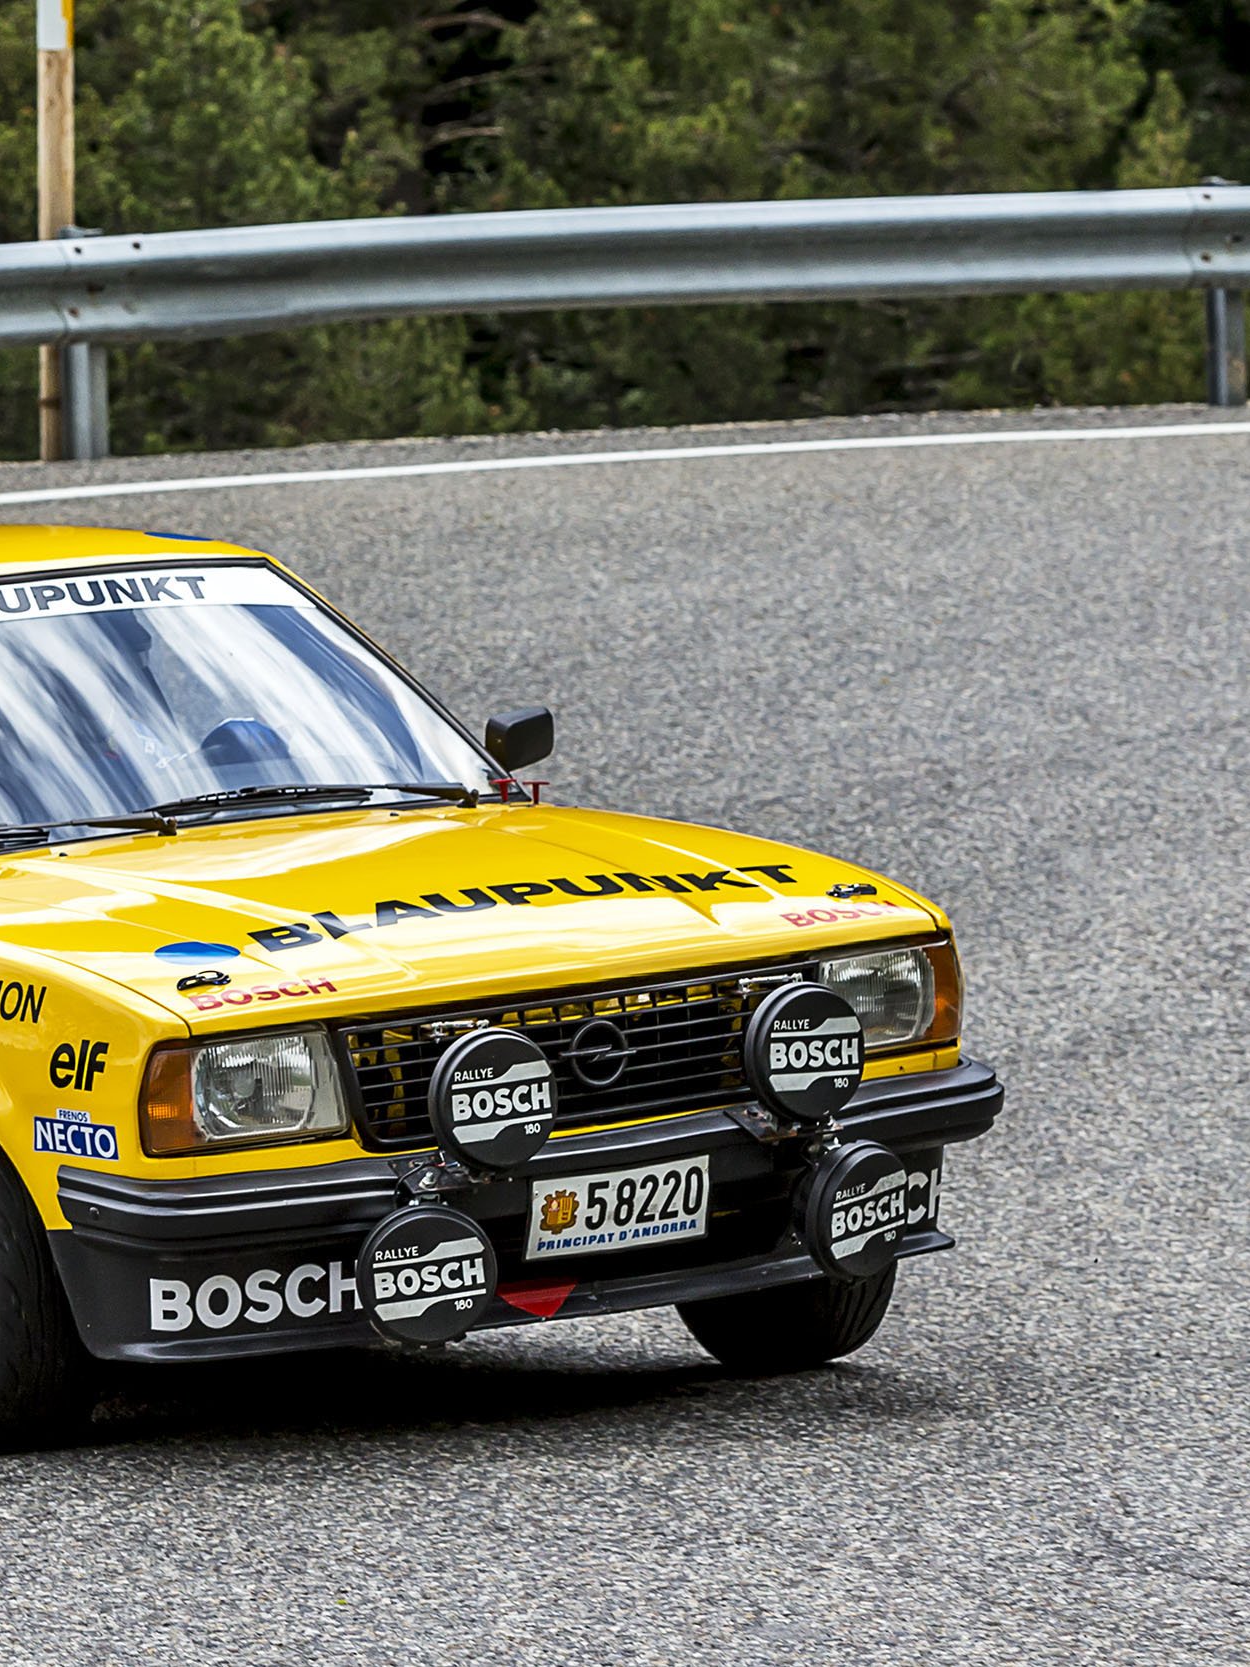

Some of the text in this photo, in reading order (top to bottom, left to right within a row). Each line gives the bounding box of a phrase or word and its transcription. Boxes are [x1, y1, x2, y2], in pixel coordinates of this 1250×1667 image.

[247, 863, 799, 954] BLAUPUNKT
[189, 977, 338, 1011] BOSCH
[773, 1018, 810, 1031] RALLYE
[49, 1039, 110, 1092] elf
[769, 1038, 859, 1070] BOSCH
[454, 1067, 494, 1082] RALLYE
[834, 1077, 849, 1089] 180
[58, 1109, 88, 1122] FRENOS
[452, 1081, 552, 1122] BOSCH
[35, 1121, 116, 1158] NECTO
[524, 1122, 541, 1135] 180
[584, 1166, 704, 1231] 58220
[835, 1183, 866, 1201] RALLYE
[831, 1189, 905, 1239] BOSCH
[536, 1219, 697, 1251] PRINCIPAT D'ANDORRA
[374, 1245, 419, 1261] RALLYE
[373, 1258, 485, 1299] BOSCH
[150, 1260, 364, 1332] BOSCH
[454, 1298, 473, 1311] 180
